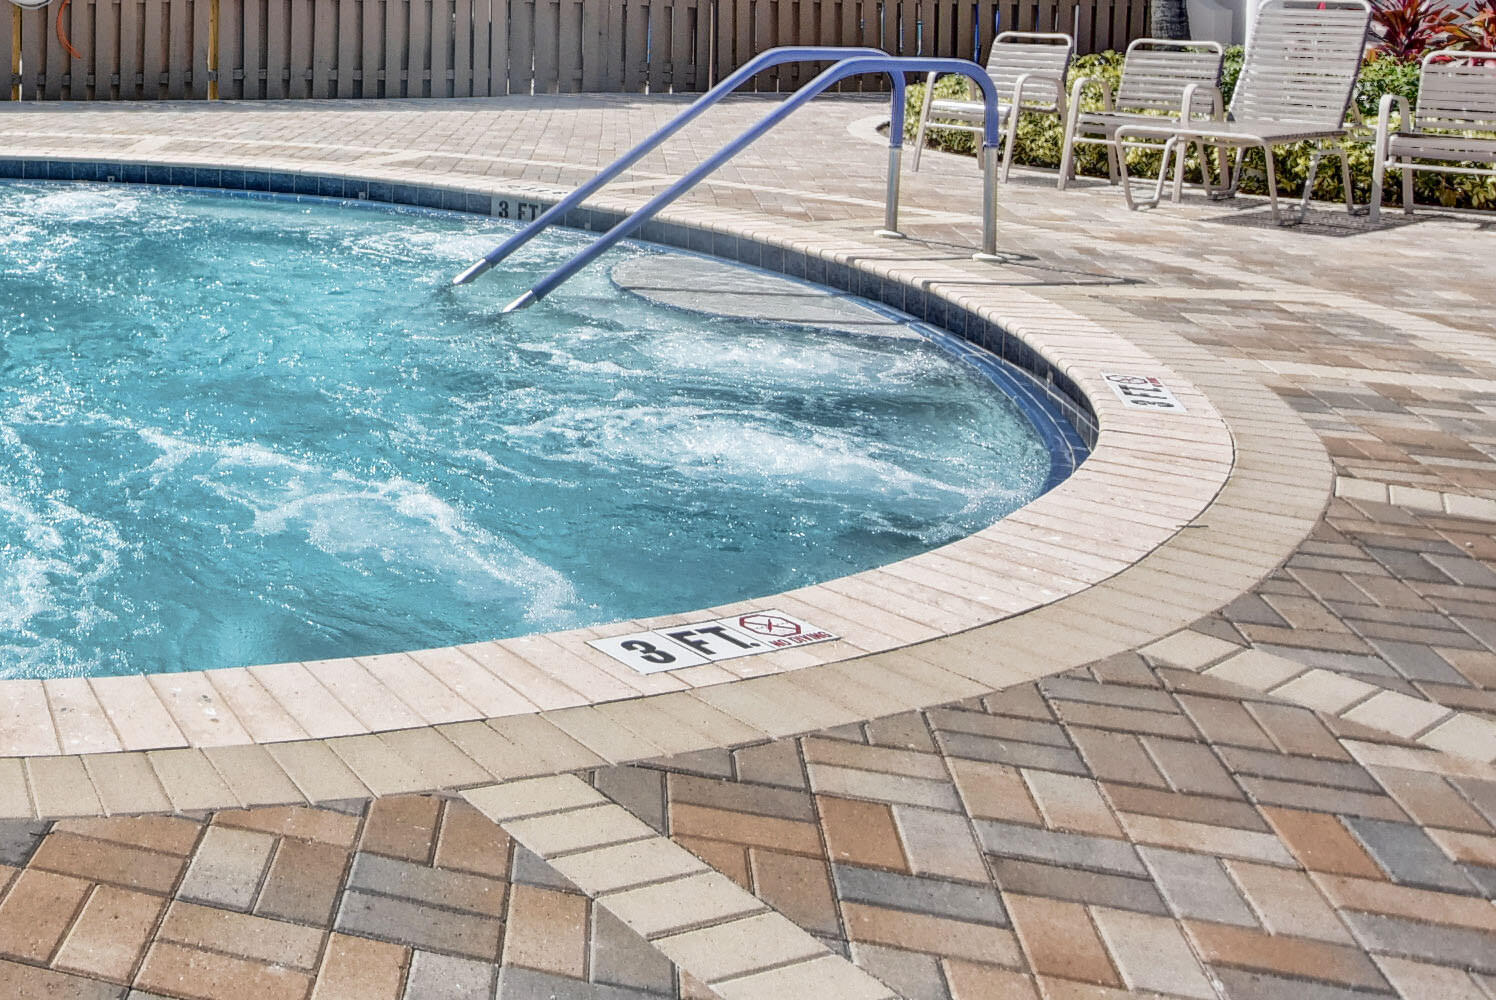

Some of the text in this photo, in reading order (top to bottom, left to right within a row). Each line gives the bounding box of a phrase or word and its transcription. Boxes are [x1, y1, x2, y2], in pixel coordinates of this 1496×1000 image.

[498, 201, 538, 220] 3 FT
[620, 626, 761, 664] 3 FT.
[768, 631, 833, 647] NO DIVING
